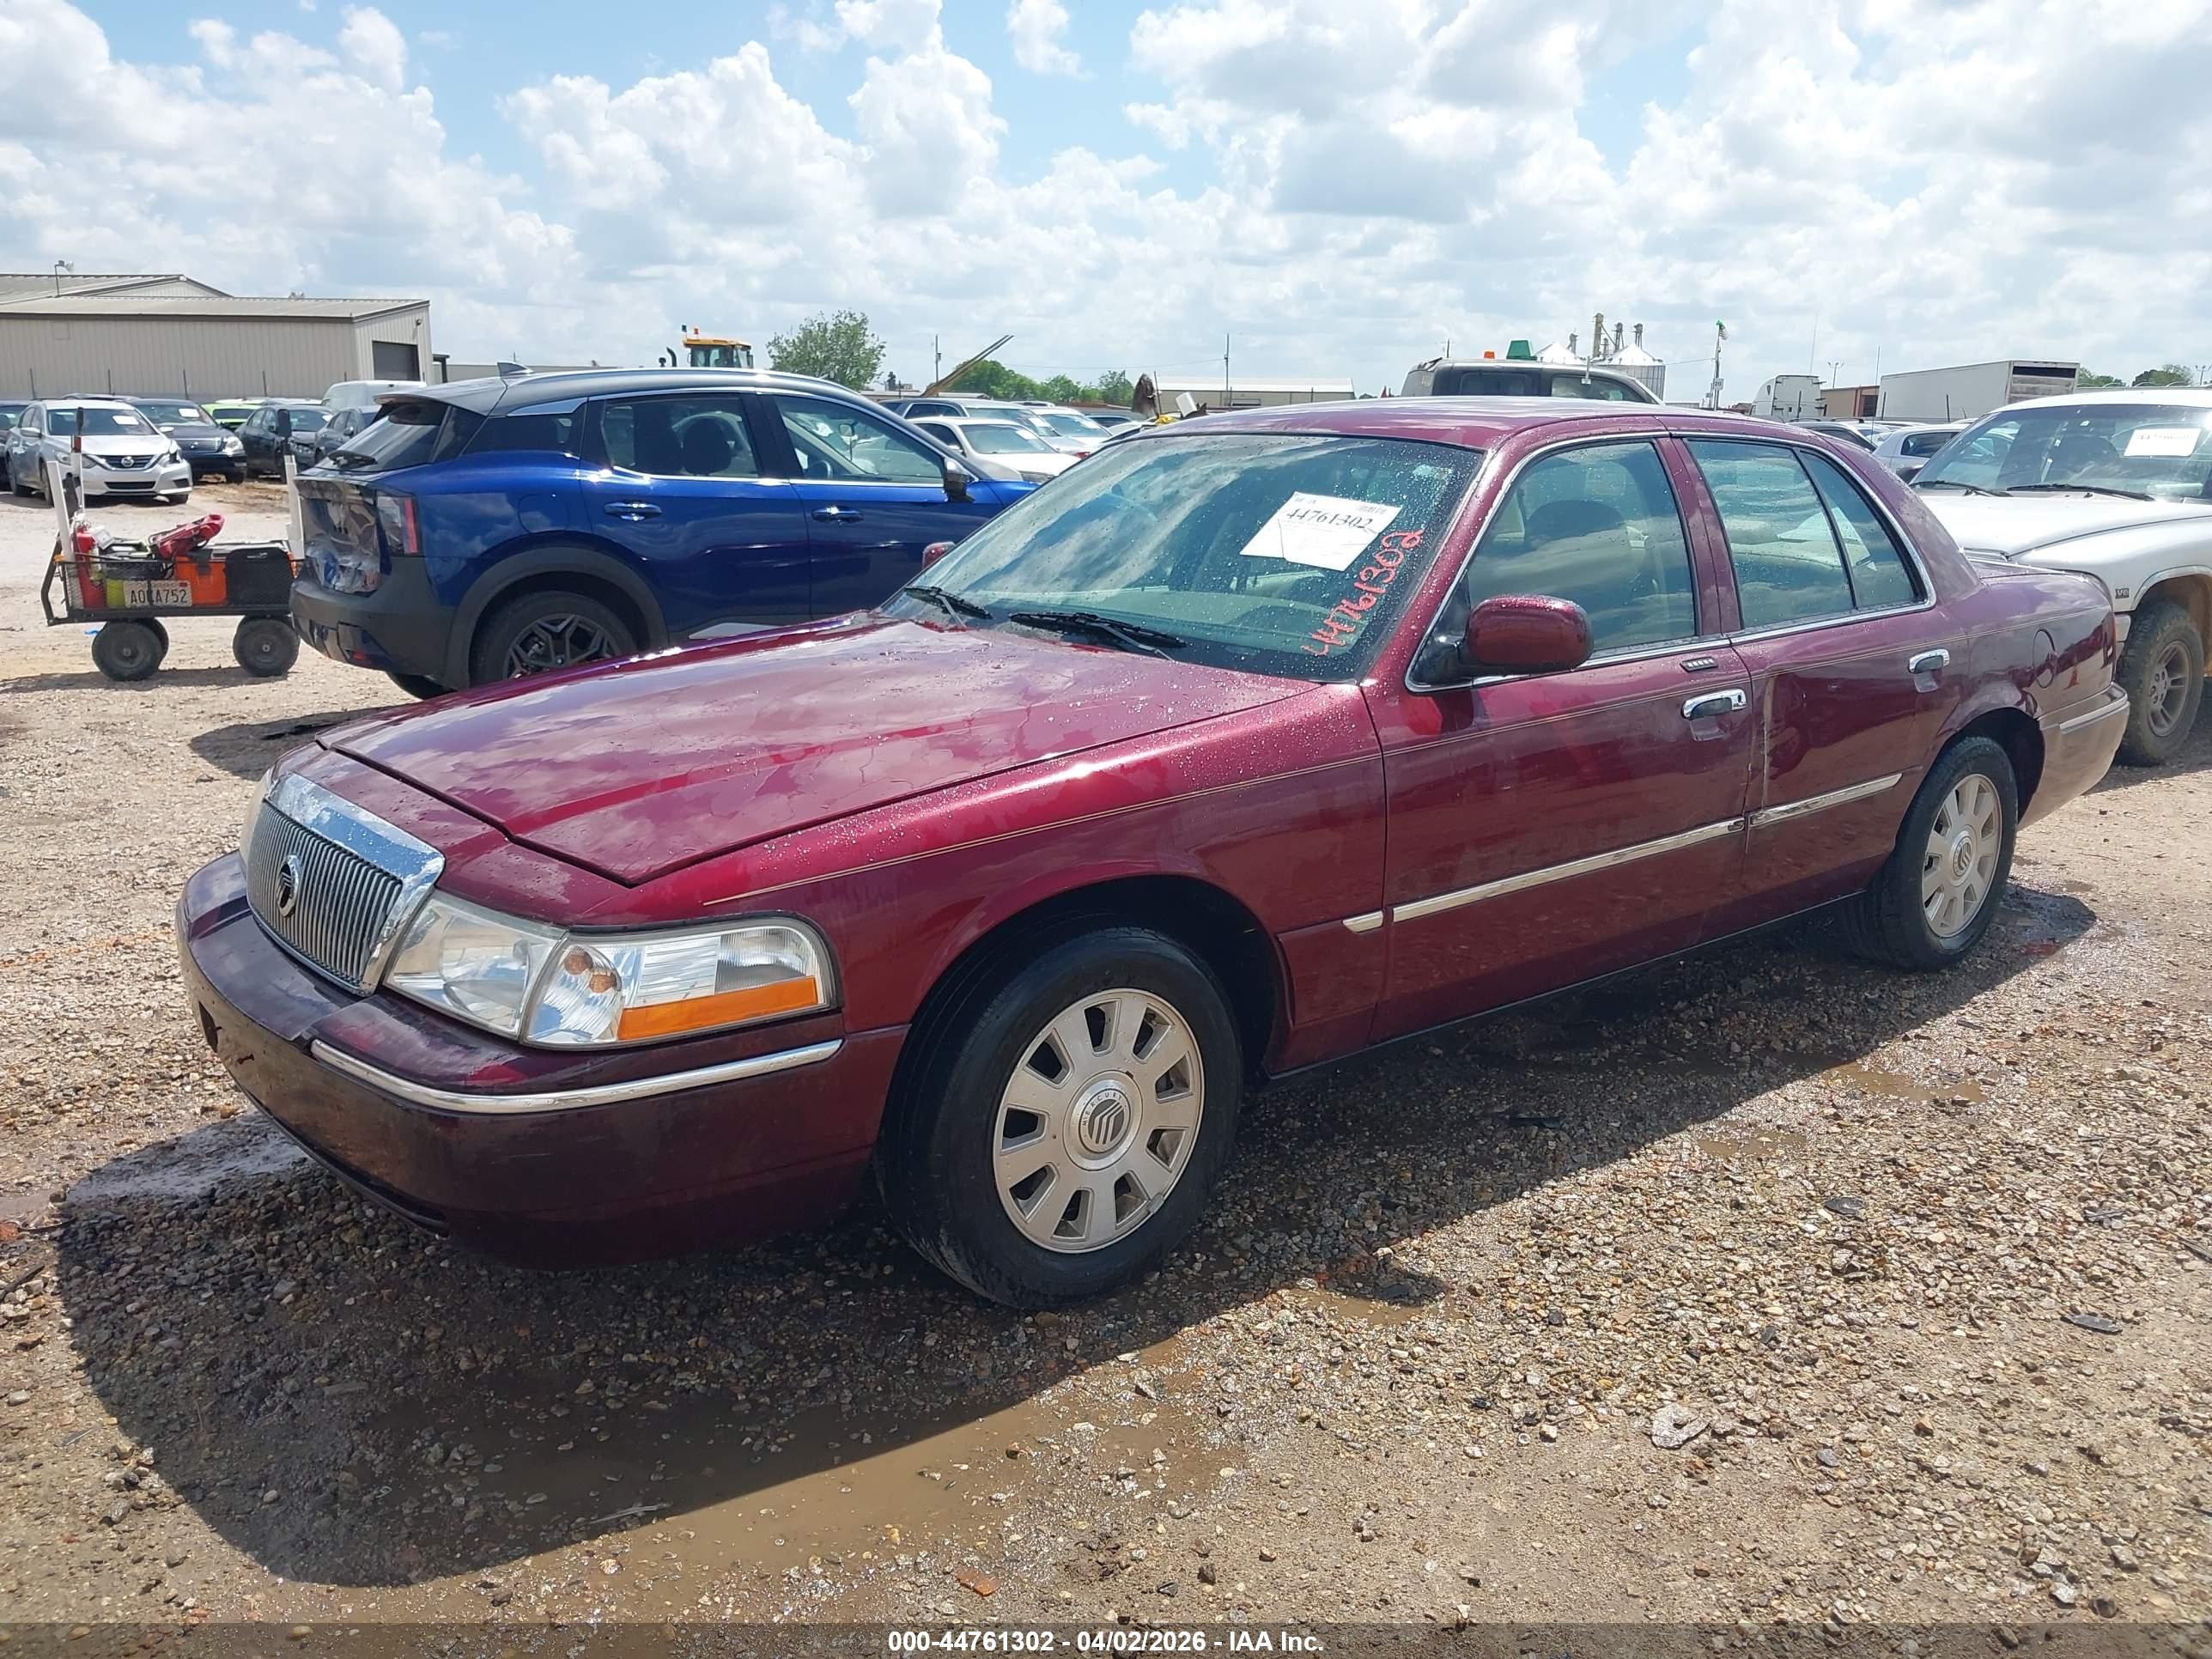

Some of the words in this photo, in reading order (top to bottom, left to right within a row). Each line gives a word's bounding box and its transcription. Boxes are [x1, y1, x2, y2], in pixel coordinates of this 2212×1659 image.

[1286, 508, 1373, 529] 44761302
[1300, 530, 1425, 656] 44761302
[1082, 1092, 1122, 1126] MERCURY
